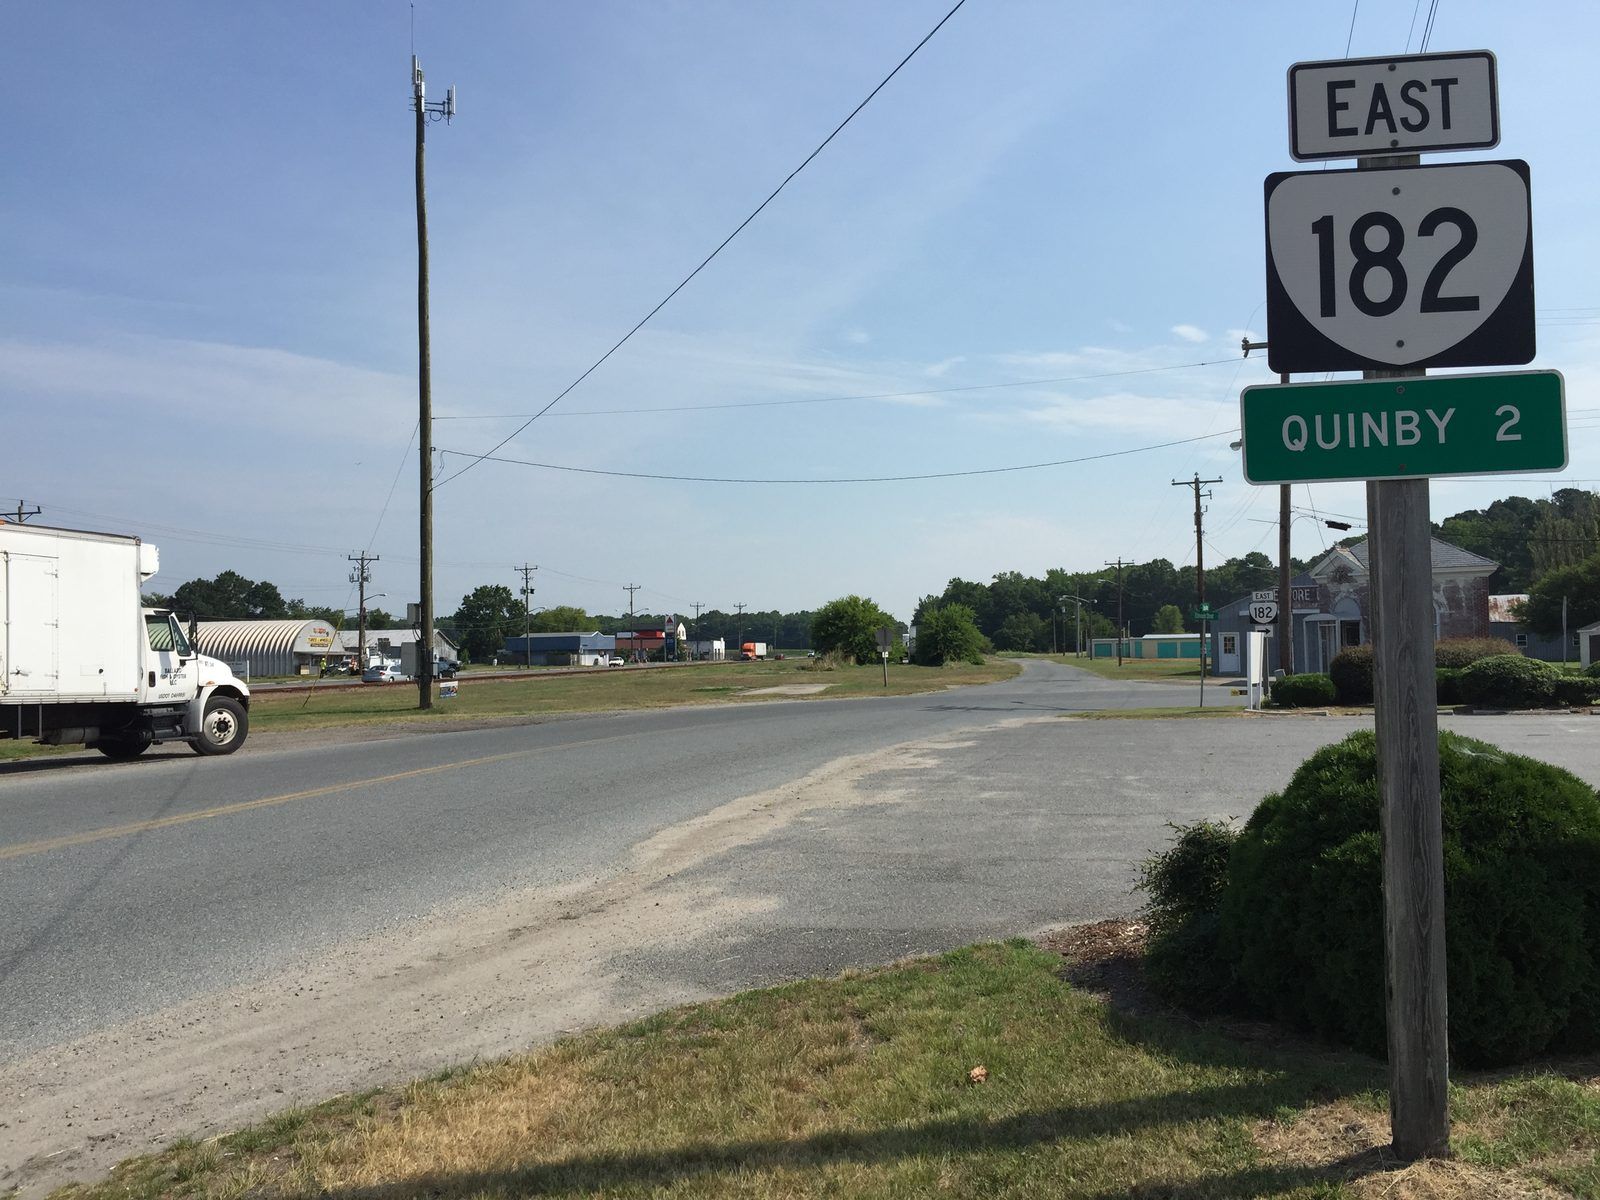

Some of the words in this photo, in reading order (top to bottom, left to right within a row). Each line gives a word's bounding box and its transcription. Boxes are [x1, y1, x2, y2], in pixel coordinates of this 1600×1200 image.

[1326, 77, 1459, 138] EAST
[1311, 206, 1481, 318] 182
[1282, 407, 1456, 452] QUINBY
[1494, 405, 1522, 441] 2
[1253, 606, 1273, 619] 182
[1255, 592, 1271, 600] EAST
